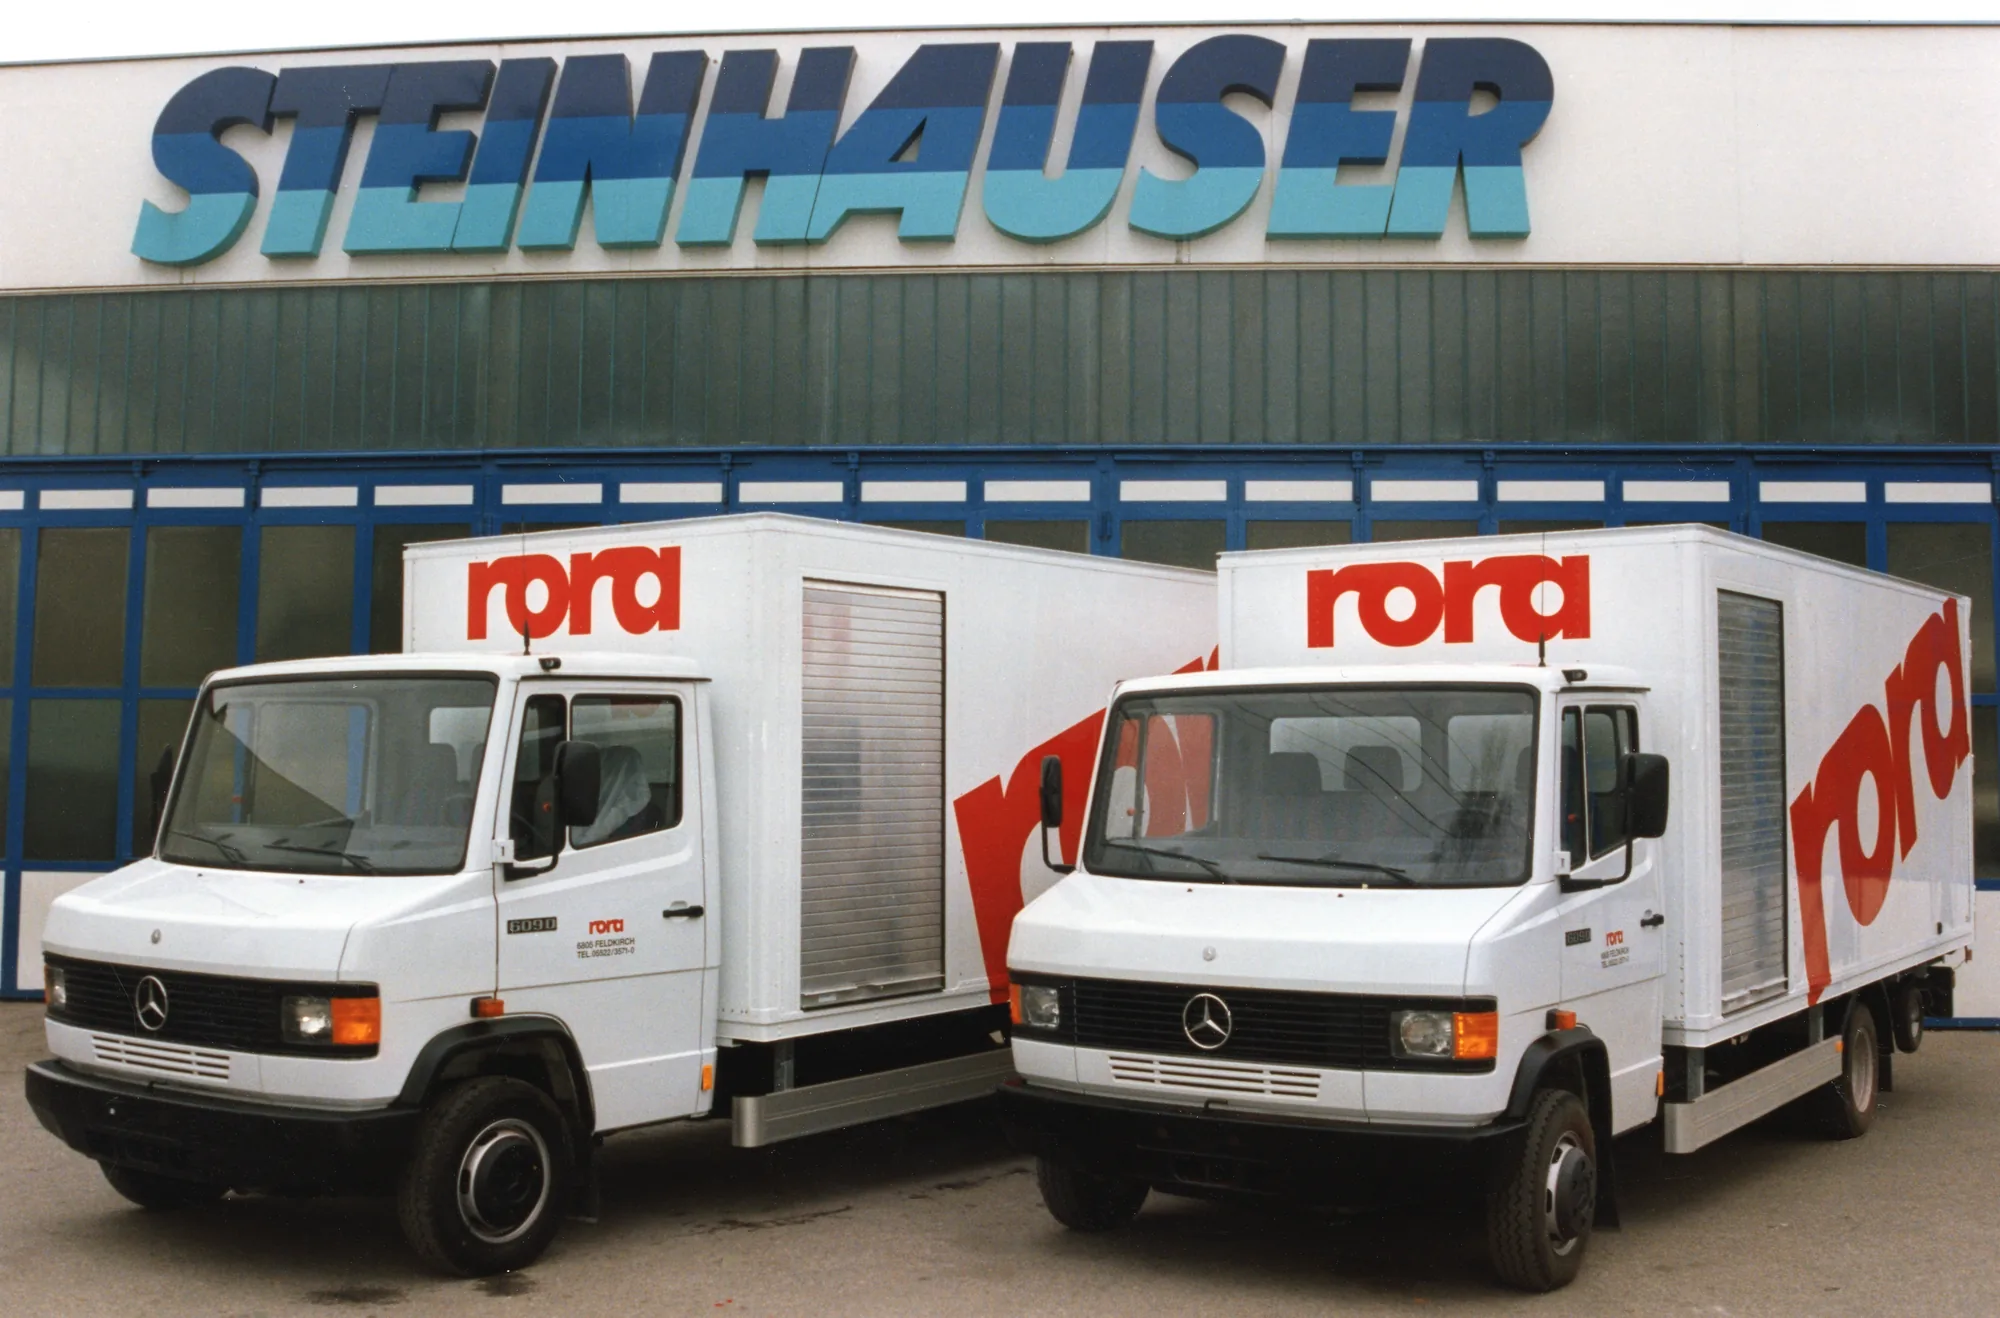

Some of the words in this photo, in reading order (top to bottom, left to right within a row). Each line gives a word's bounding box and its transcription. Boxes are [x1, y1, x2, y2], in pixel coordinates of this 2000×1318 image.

[131, 35, 1554, 265] STEINHAUSER
[467, 546, 681, 640] rora
[1307, 555, 1591, 648] rora
[1790, 597, 1970, 1006] rora
[589, 919, 624, 934] rora
[595, 937, 635, 948] FELDKIRCH
